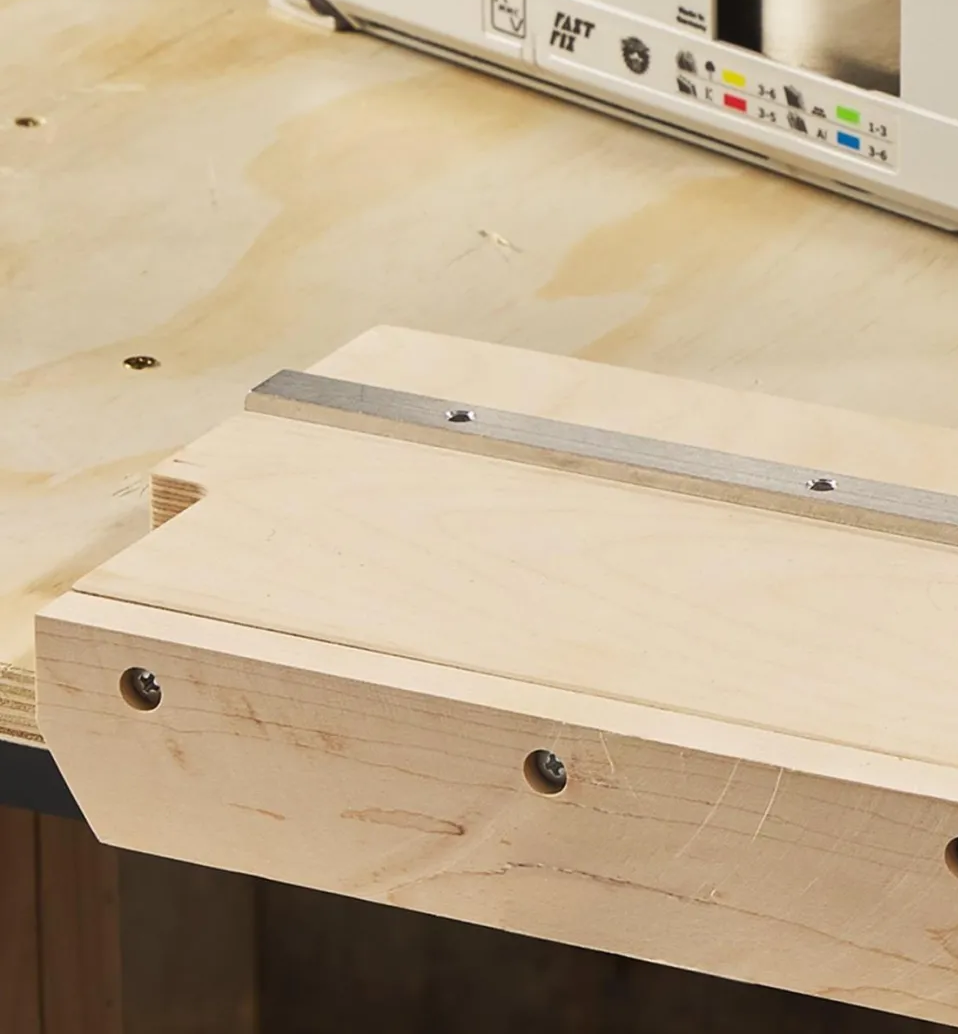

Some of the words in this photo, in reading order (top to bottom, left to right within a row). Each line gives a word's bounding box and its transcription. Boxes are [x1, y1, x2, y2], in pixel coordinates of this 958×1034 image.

[554, 11, 596, 39] FAST
[549, 29, 576, 54] FIX
[758, 84, 776, 101] 3-6
[758, 107, 776, 124] 3-5
[868, 122, 887, 138] 1-3
[868, 145, 887, 162] 3-6
